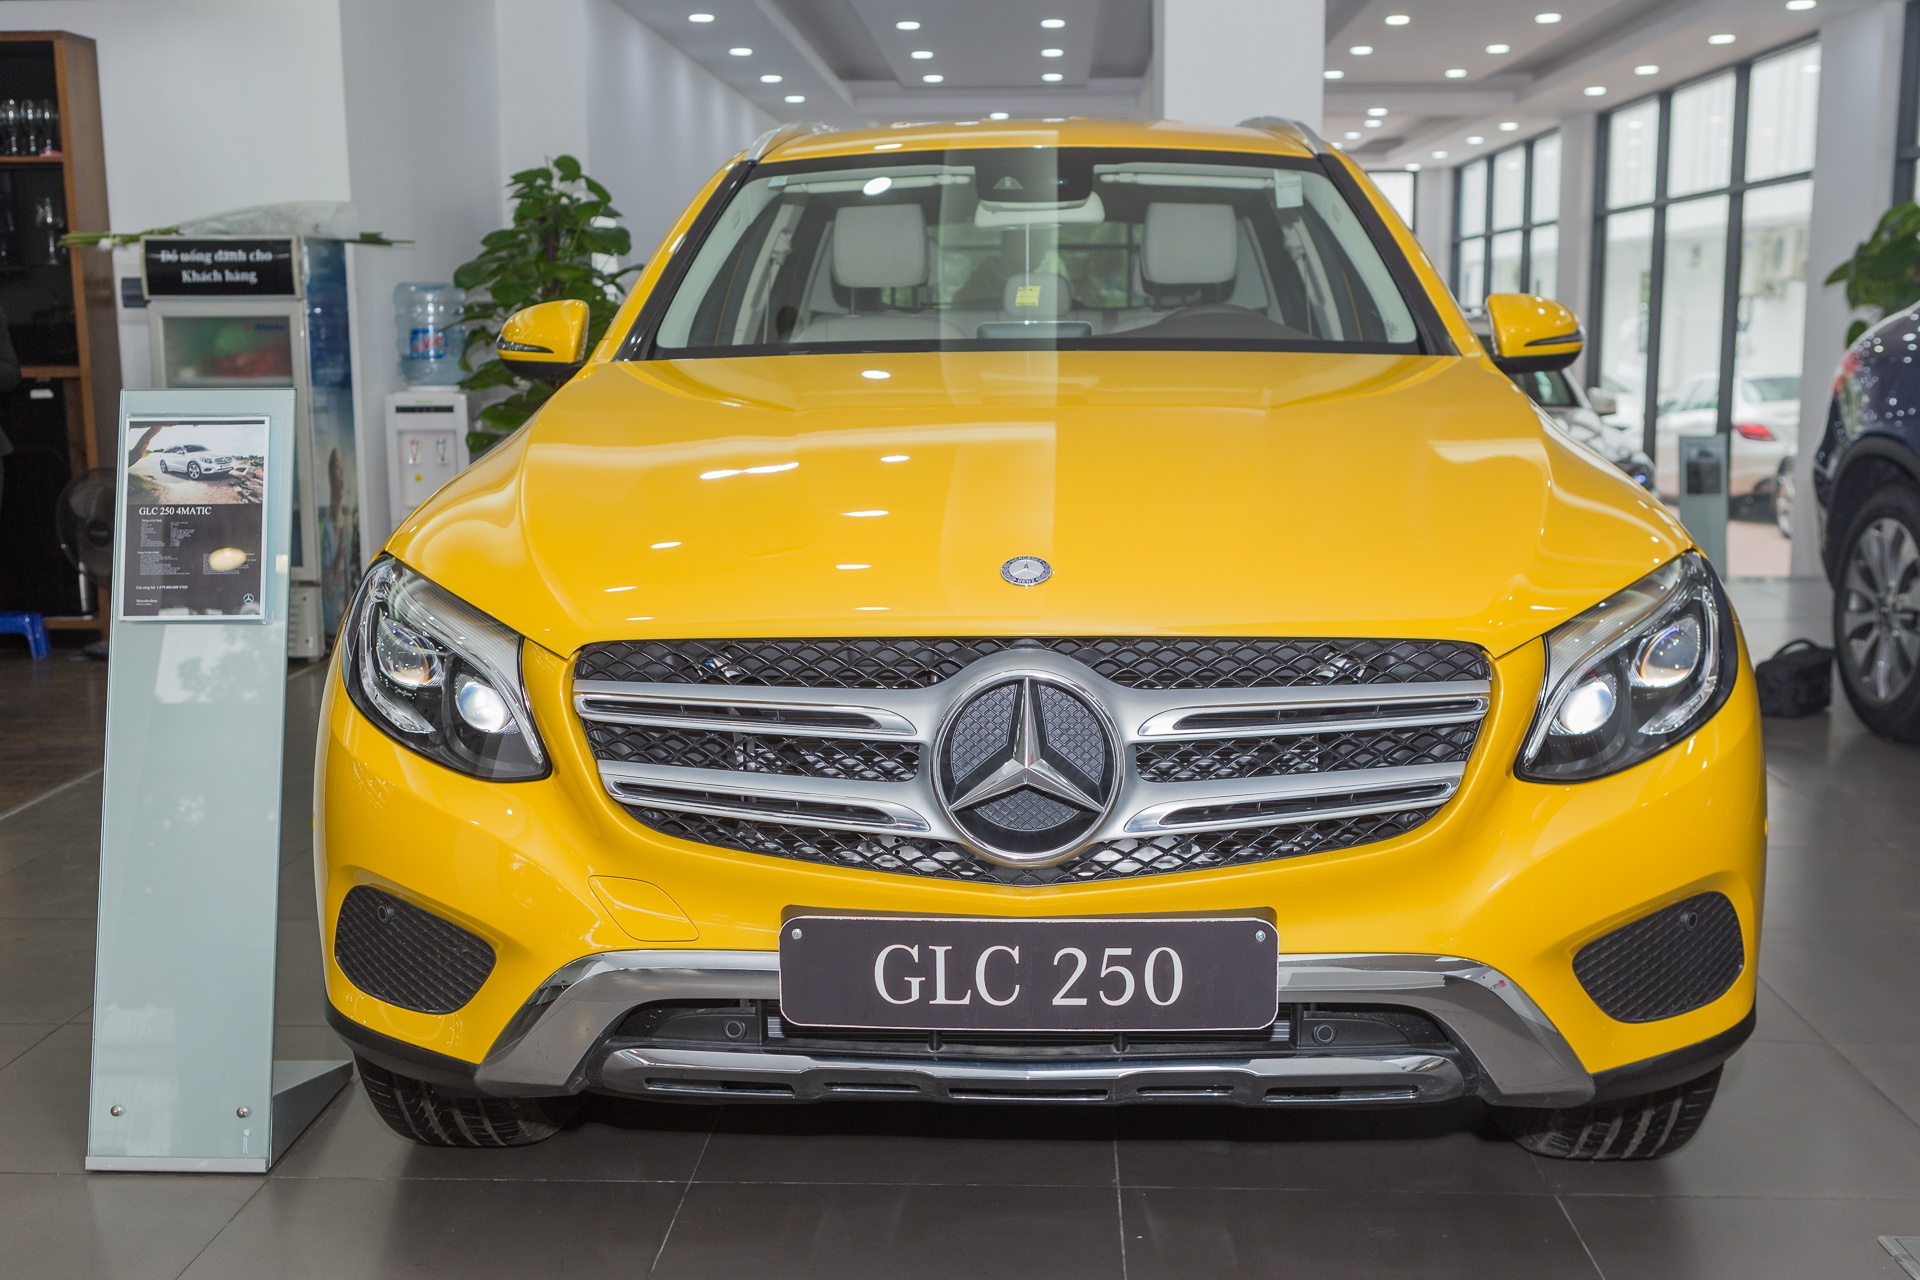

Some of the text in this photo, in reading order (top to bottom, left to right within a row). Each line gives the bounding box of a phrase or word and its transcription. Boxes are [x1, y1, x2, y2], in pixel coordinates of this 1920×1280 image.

[180, 248, 212, 265] uống
[214, 249, 247, 262] dành
[249, 249, 273, 262] cho
[181, 269, 258, 285] Khách hàng
[138, 506, 212, 516] GLC 250 4MATIC
[873, 944, 1184, 1006] GLC 250
